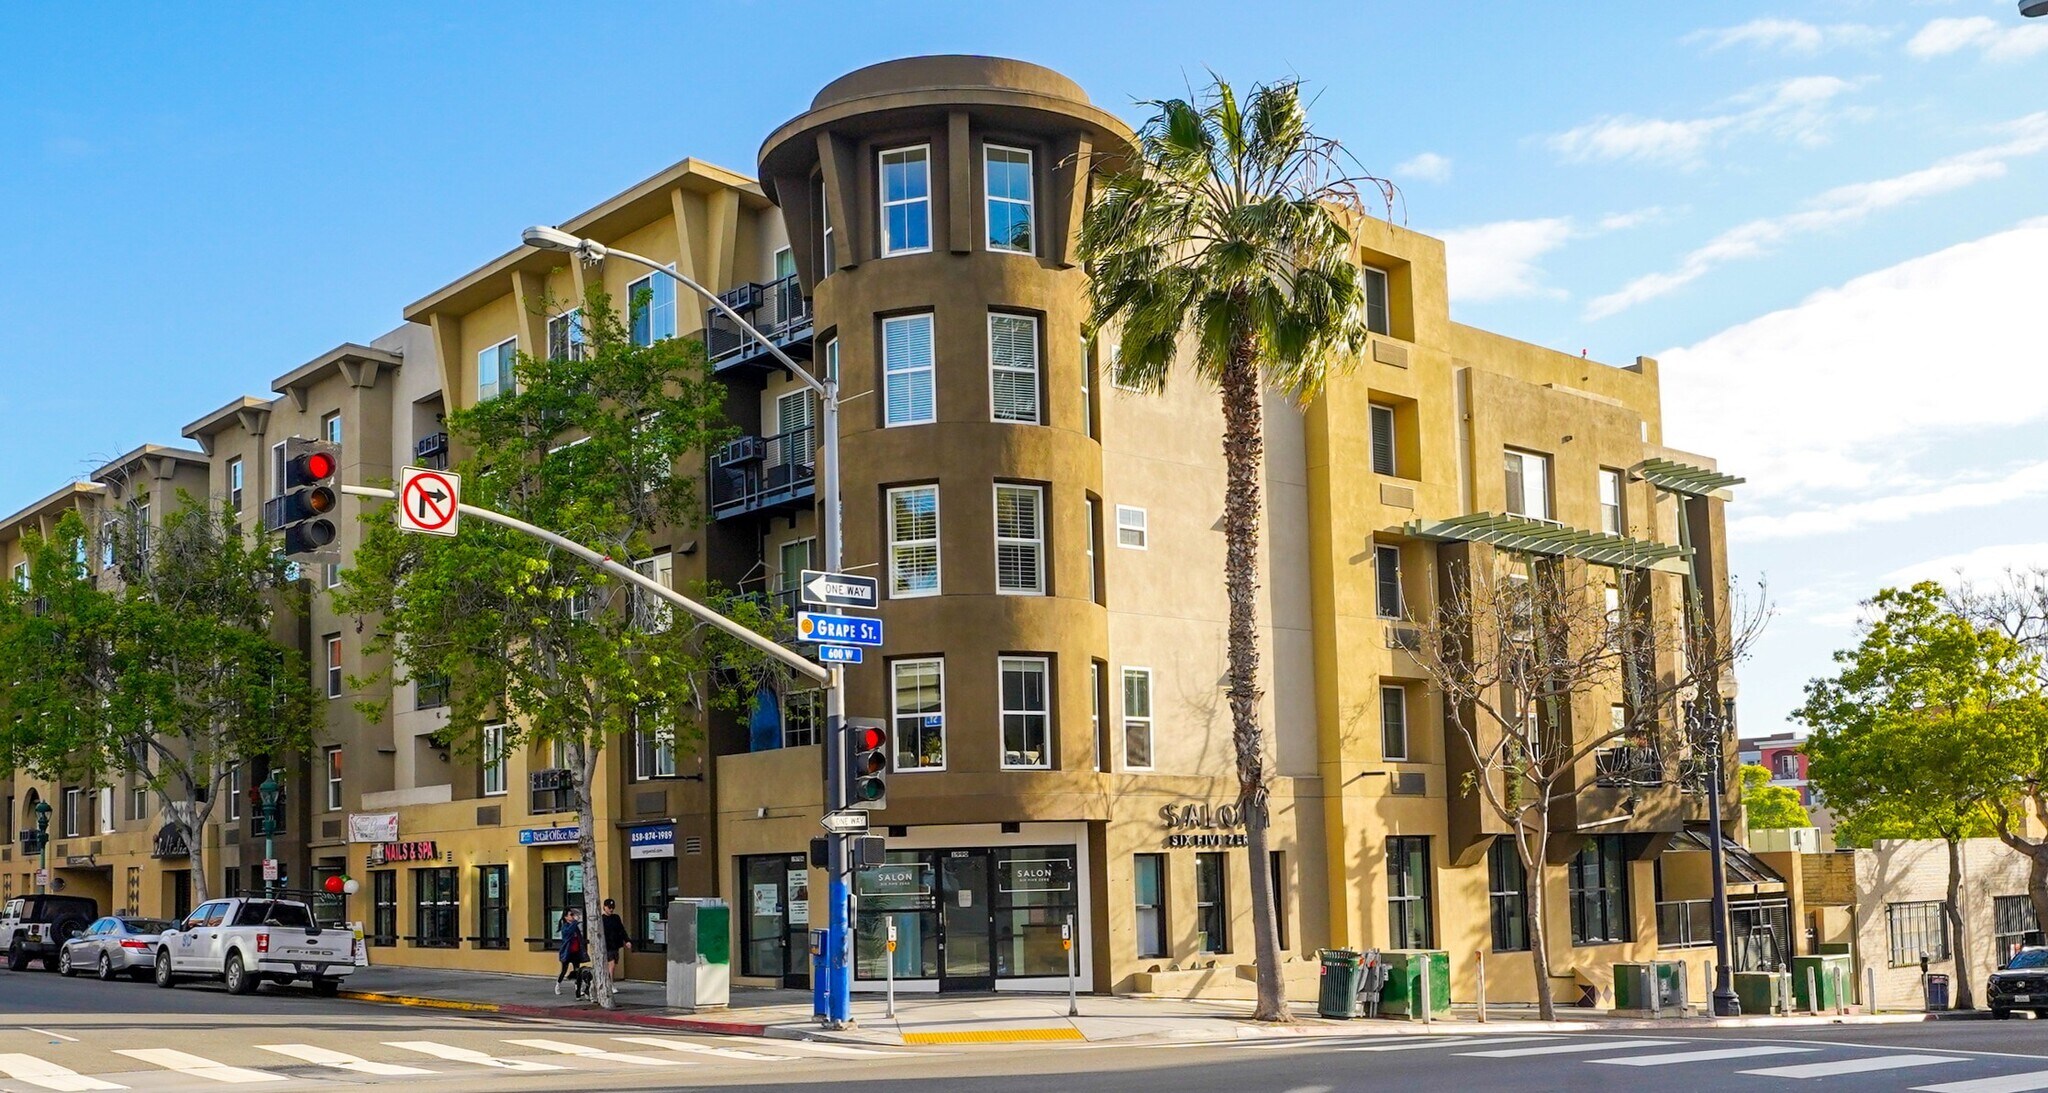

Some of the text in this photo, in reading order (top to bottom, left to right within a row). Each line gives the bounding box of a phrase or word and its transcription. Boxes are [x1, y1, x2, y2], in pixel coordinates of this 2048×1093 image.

[826, 584, 866, 597] ONE WAY
[817, 620, 856, 638] GRAPE
[828, 649, 854, 660] 600 W
[836, 816, 864, 826] ONE WAY
[1165, 803, 1244, 829] SALO
[631, 830, 673, 842] 858-874-1989
[1171, 835, 1192, 846] SIX
[1197, 835, 1223, 846] FIVE
[385, 841, 433, 861] NAILS & SPA
[878, 873, 912, 882] SALON
[1017, 869, 1052, 878] SALON
